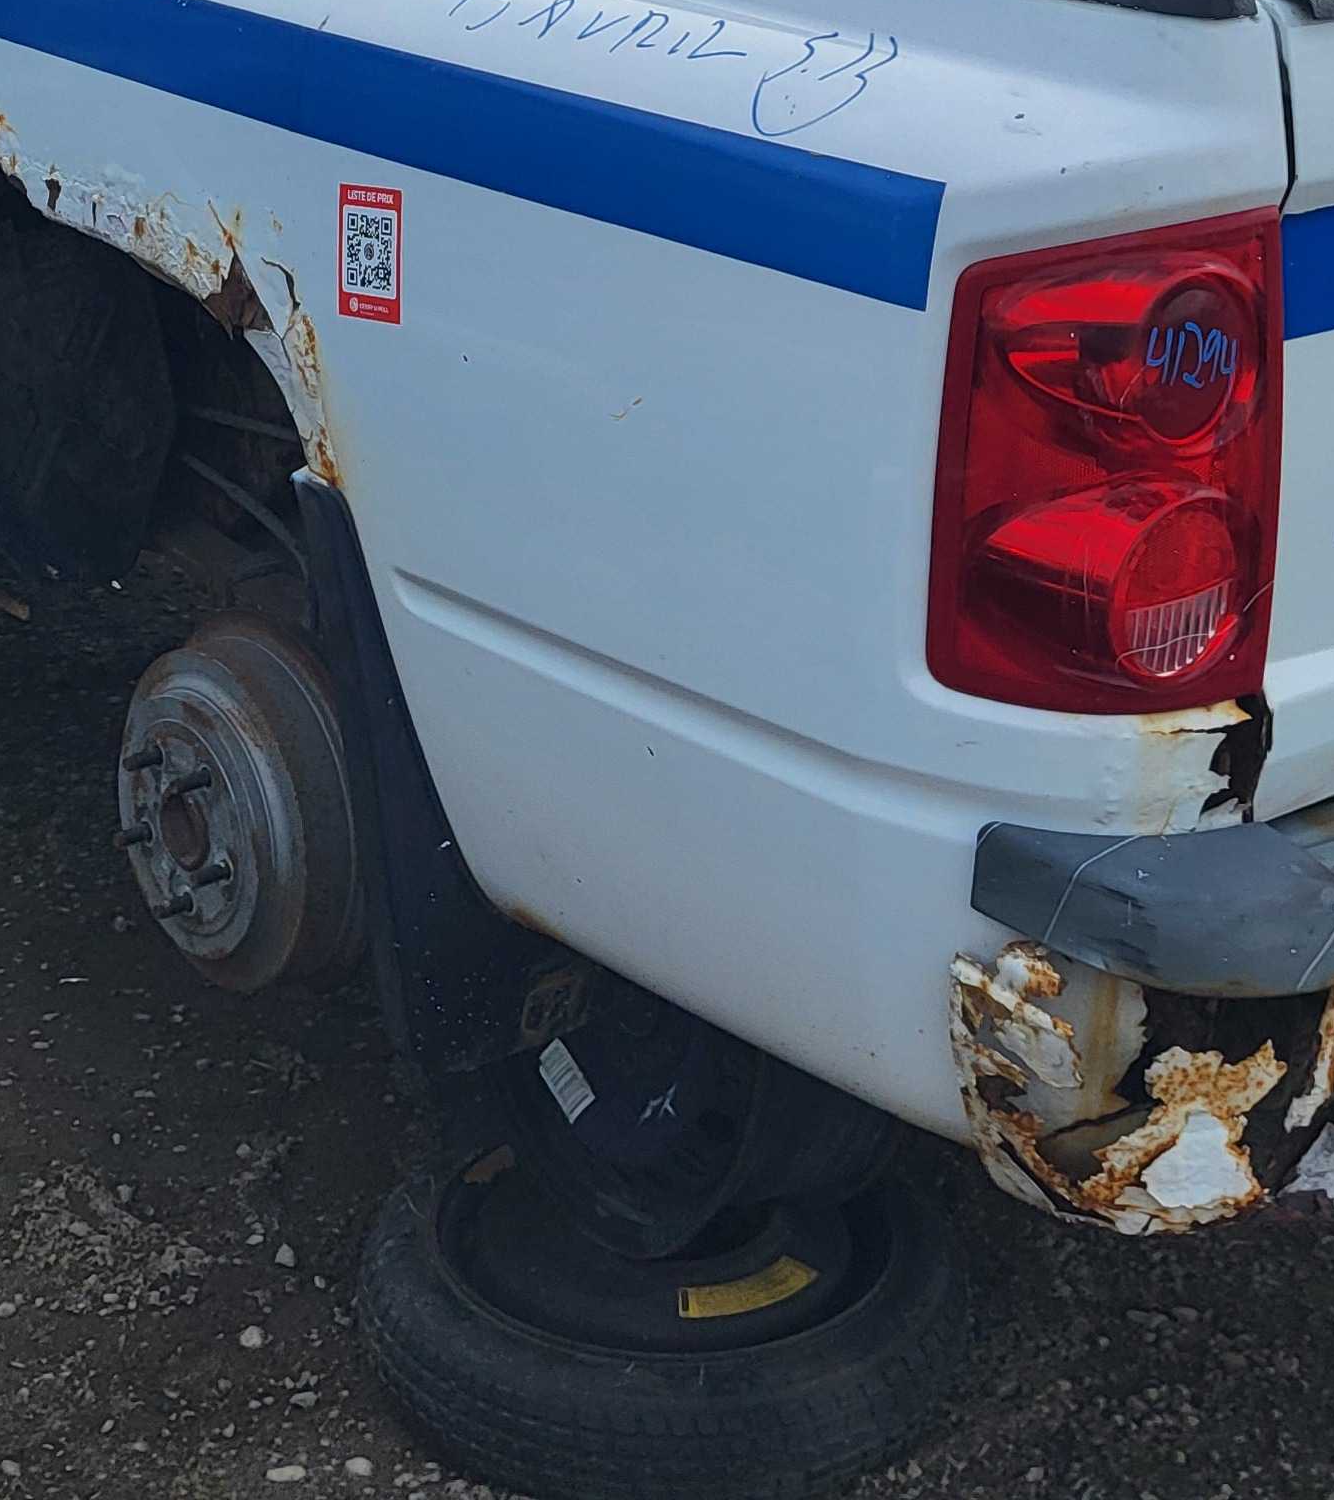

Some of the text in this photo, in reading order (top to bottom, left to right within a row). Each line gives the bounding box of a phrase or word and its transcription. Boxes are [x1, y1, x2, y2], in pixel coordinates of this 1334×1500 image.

[347, 189, 394, 204] LISTE DE PRIX
[1146, 321, 1237, 390] 41294
